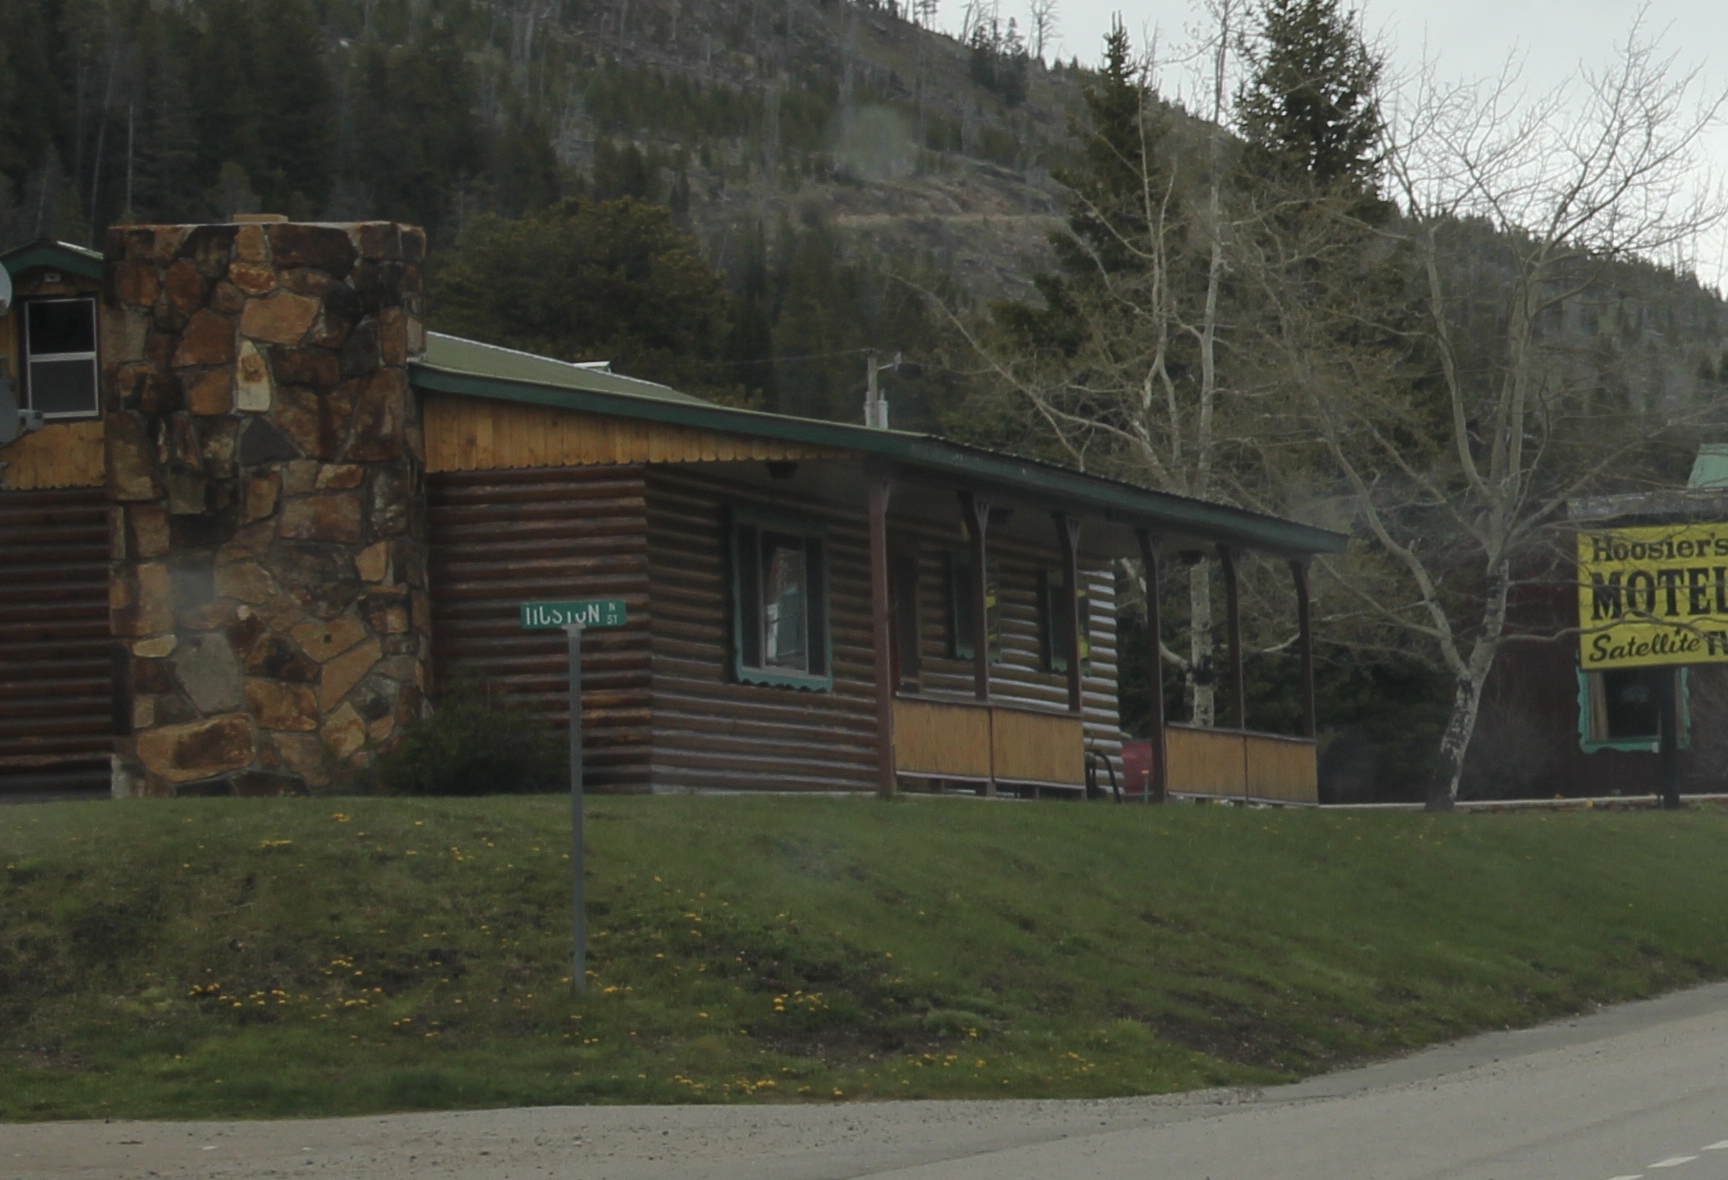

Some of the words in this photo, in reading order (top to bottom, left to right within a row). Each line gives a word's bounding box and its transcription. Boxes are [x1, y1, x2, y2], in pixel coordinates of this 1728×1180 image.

[608, 601, 616, 612] N
[607, 614, 618, 625] ST
[1588, 627, 1701, 663] Satellite
